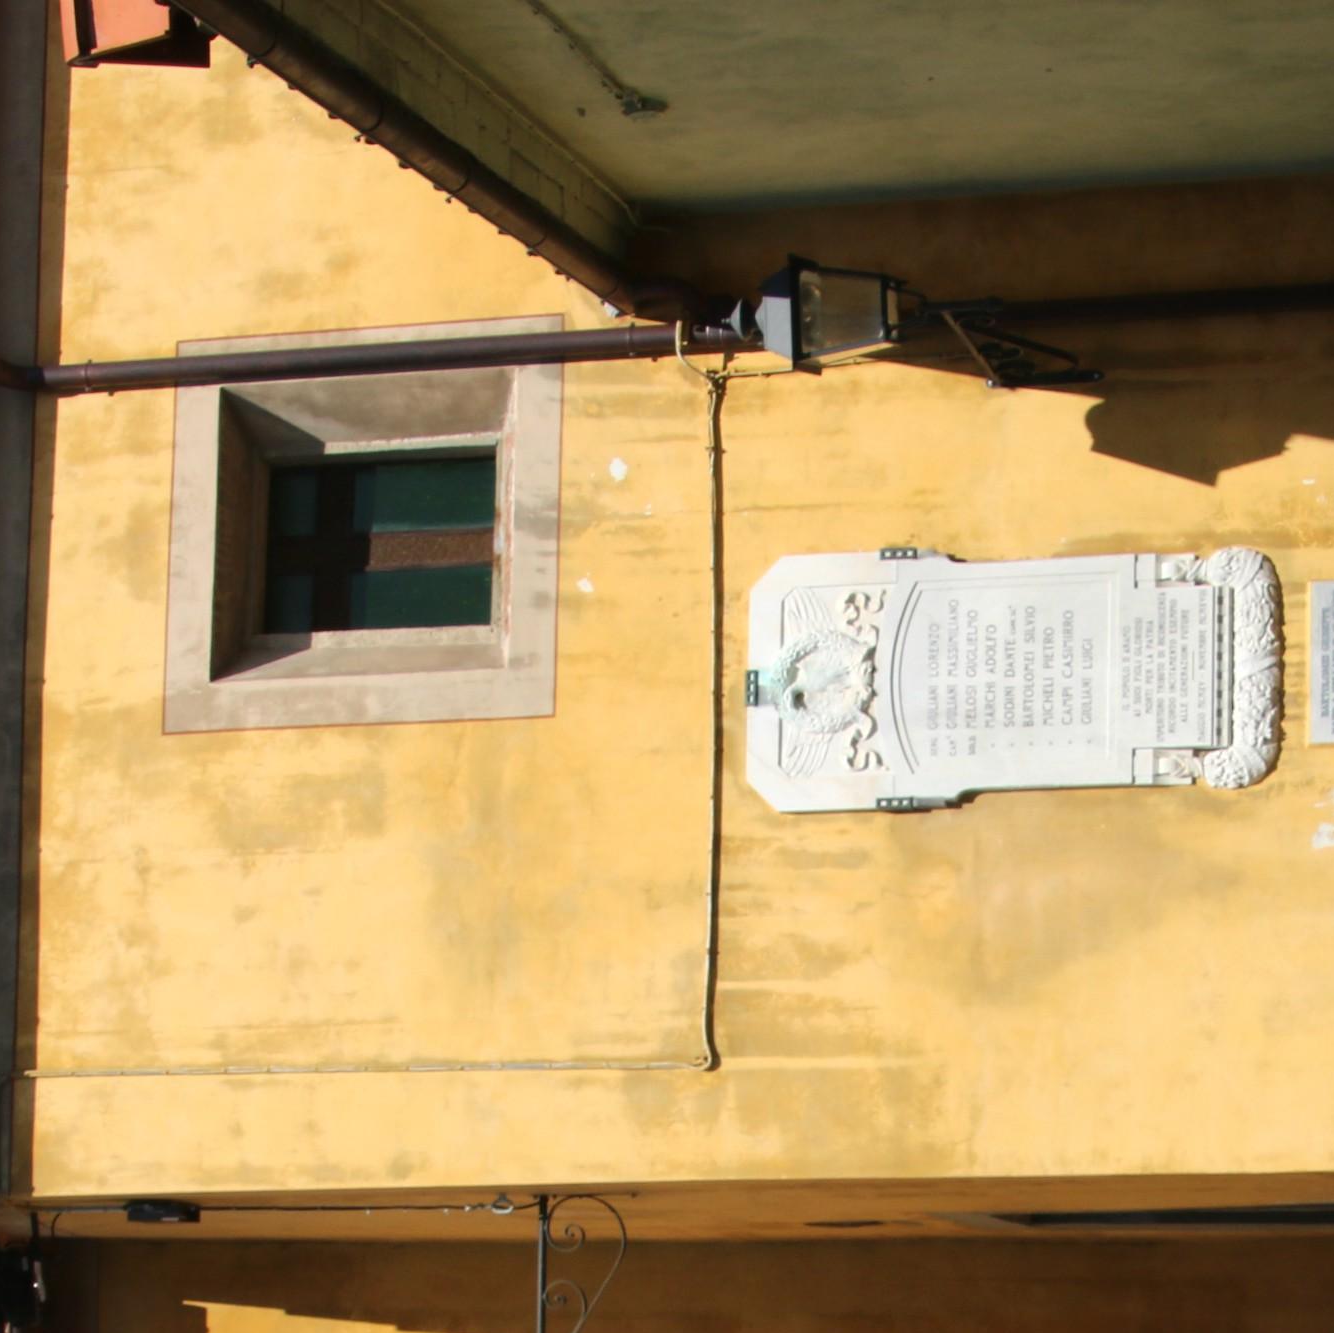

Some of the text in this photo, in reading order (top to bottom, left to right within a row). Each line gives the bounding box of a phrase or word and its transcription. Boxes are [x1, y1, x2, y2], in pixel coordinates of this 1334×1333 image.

[948, 599, 959, 677] MASSIMILIANO
[966, 610, 978, 678] GUGLIELMO
[1134, 617, 1142, 656] GLORIOSI
[1181, 609, 1189, 639] FUTURE
[928, 623, 940, 677] LORENZO
[1005, 639, 1016, 677] DANTE
[1023, 605, 1035, 727] BARTOLOMEI SILVIO
[1061, 610, 1074, 725] CAMPI CASIMIRRO
[1134, 660, 1142, 681] FIGLI
[1146, 655, 1153, 664] LA
[1169, 639, 1177, 693] INCITAMENTO
[985, 624, 996, 728] MARCHI ADOLFO
[1043, 626, 1054, 726] MICHELI PIETRO
[1081, 638, 1093, 725] GIULIANI LUIGI
[1122, 666, 1130, 698] POPOLO
[1145, 669, 1153, 684] PER
[928, 685, 939, 730] GIULIANI
[946, 684, 957, 729] GIULIANI
[966, 685, 976, 729] MELOSI
[1004, 686, 1015, 727] SODINI
[1145, 689, 1153, 714] MORTI
